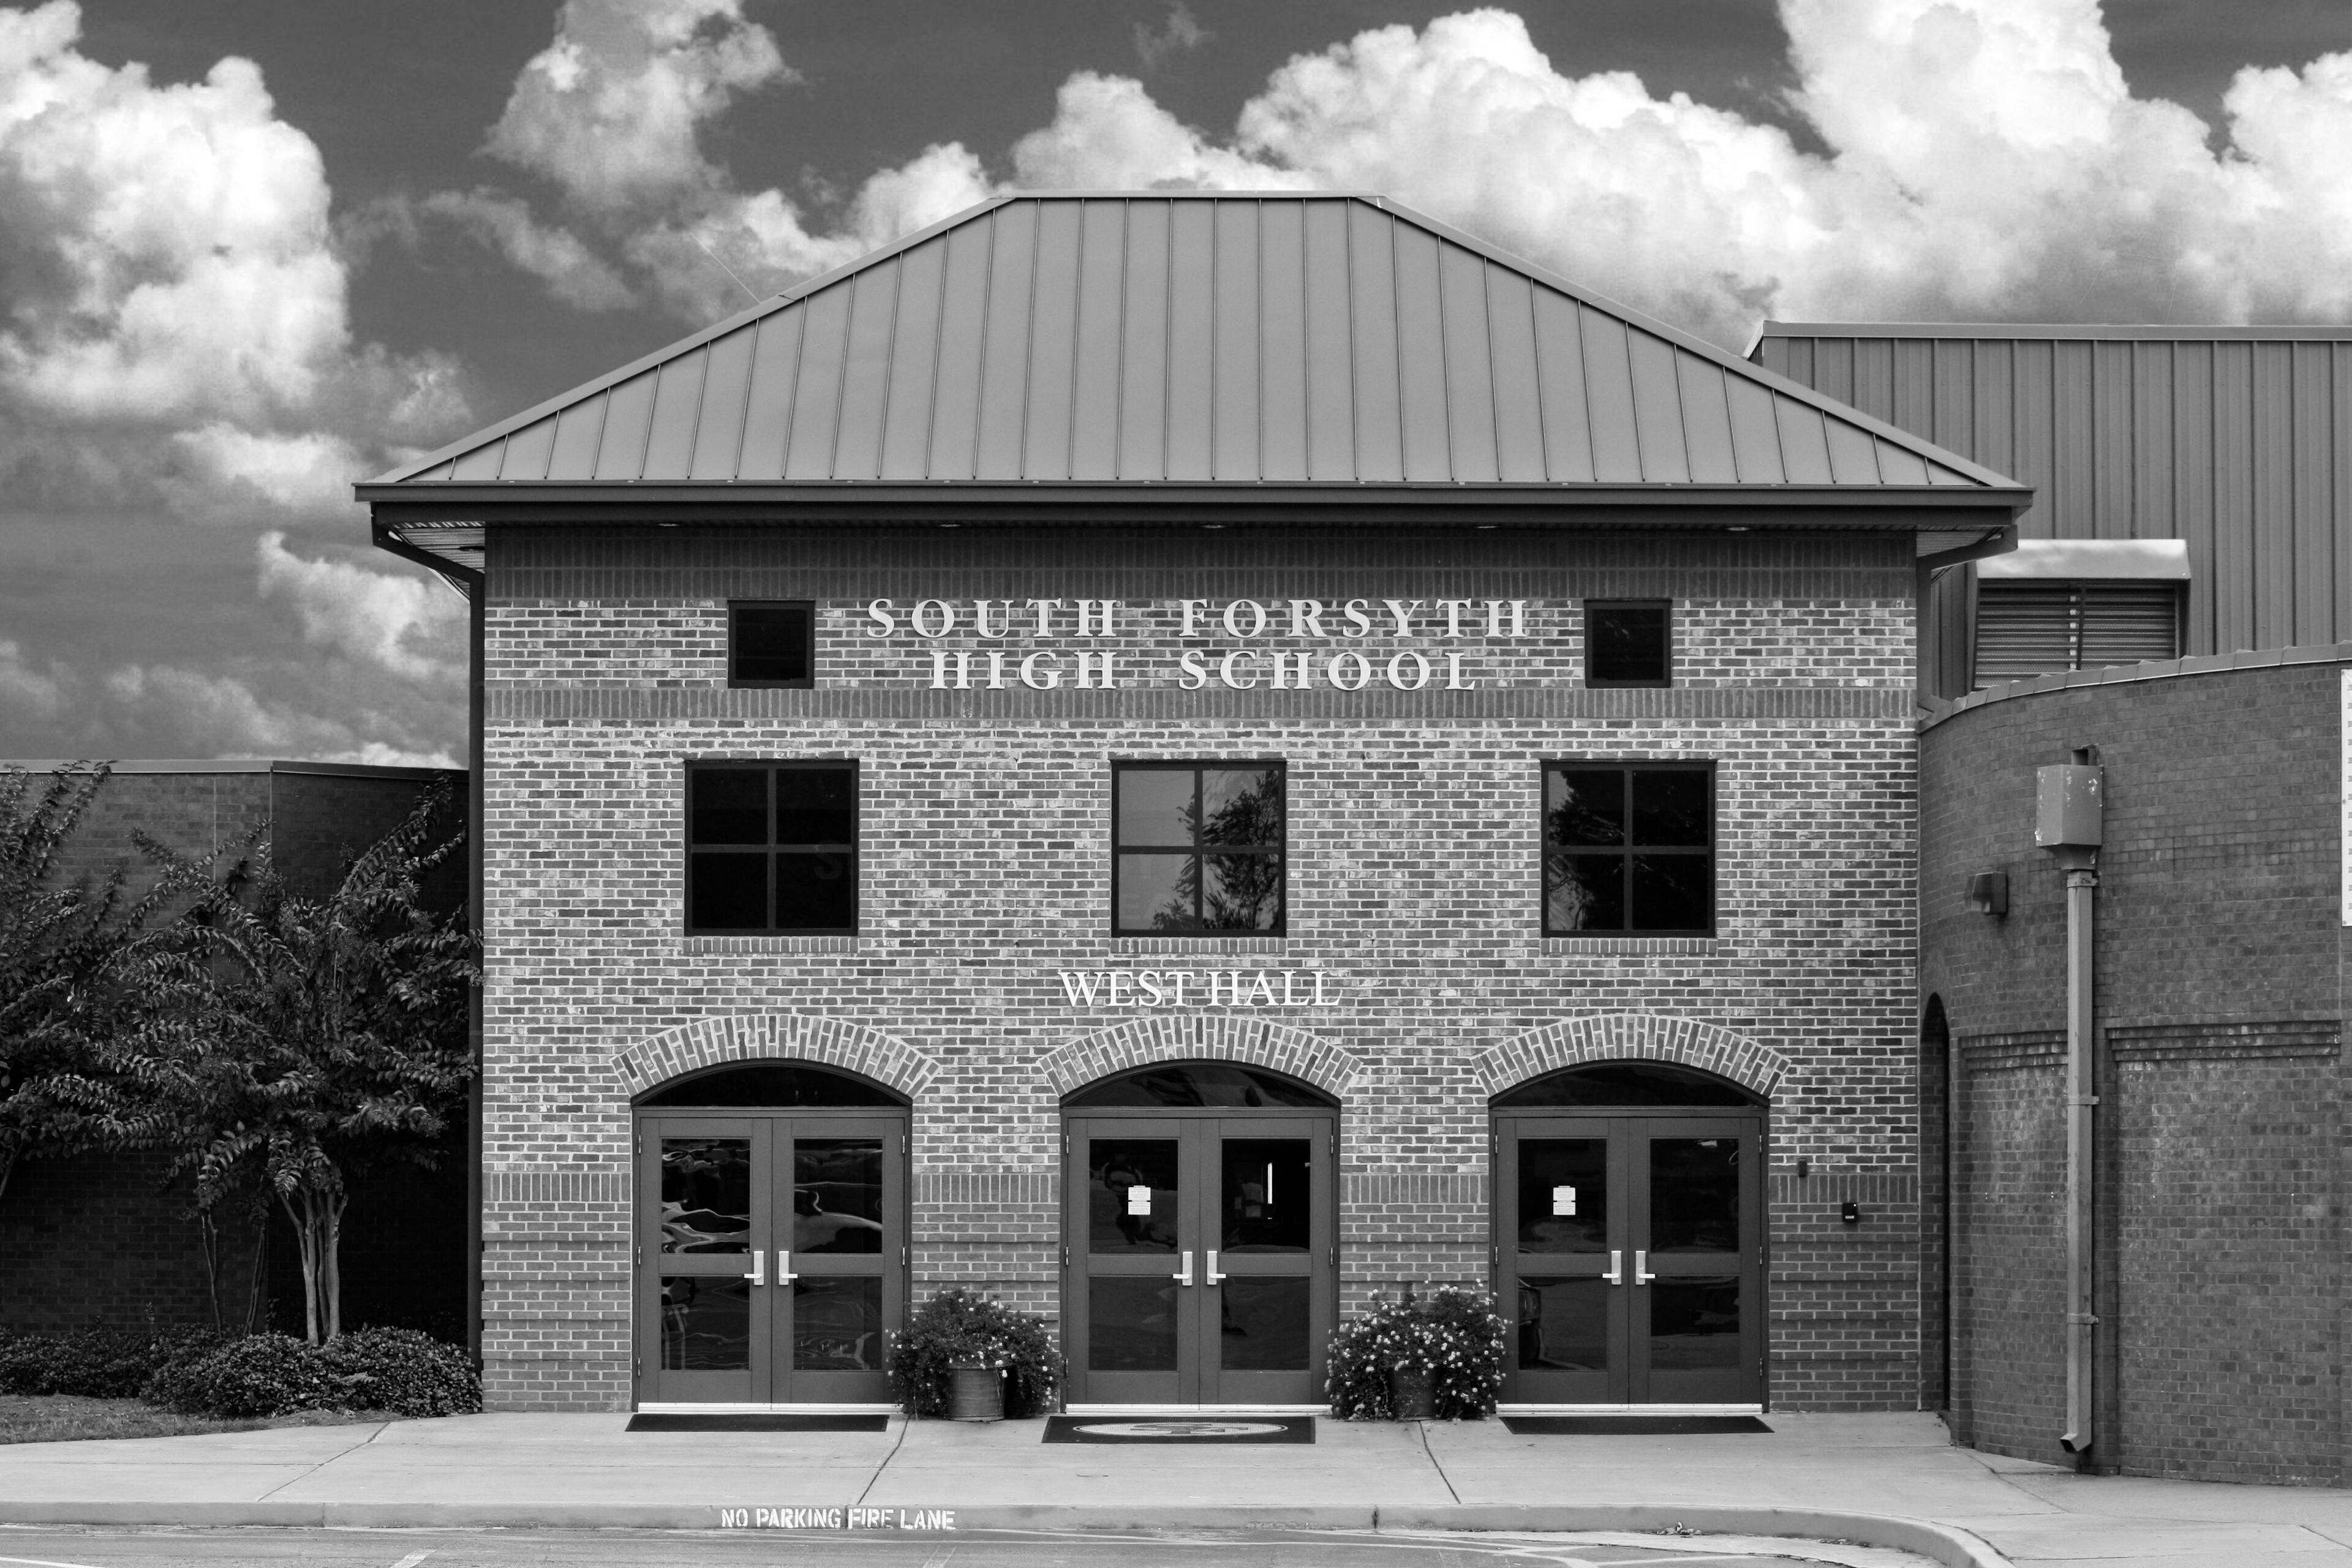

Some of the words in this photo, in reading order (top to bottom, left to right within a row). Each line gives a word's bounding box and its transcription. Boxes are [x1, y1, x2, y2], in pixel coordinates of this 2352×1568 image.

[867, 598, 1118, 638] SOUTH
[1178, 598, 1528, 638] FORSYTH
[929, 651, 1117, 690] HIGH
[1178, 650, 1477, 691] SCHOOL
[1058, 970, 1195, 1007] WEST
[1206, 970, 1341, 1006] HALL
[721, 1508, 749, 1528] NO
[756, 1508, 842, 1529] PARKING
[847, 1508, 894, 1529] FIRE
[900, 1509, 956, 1529] LANE
